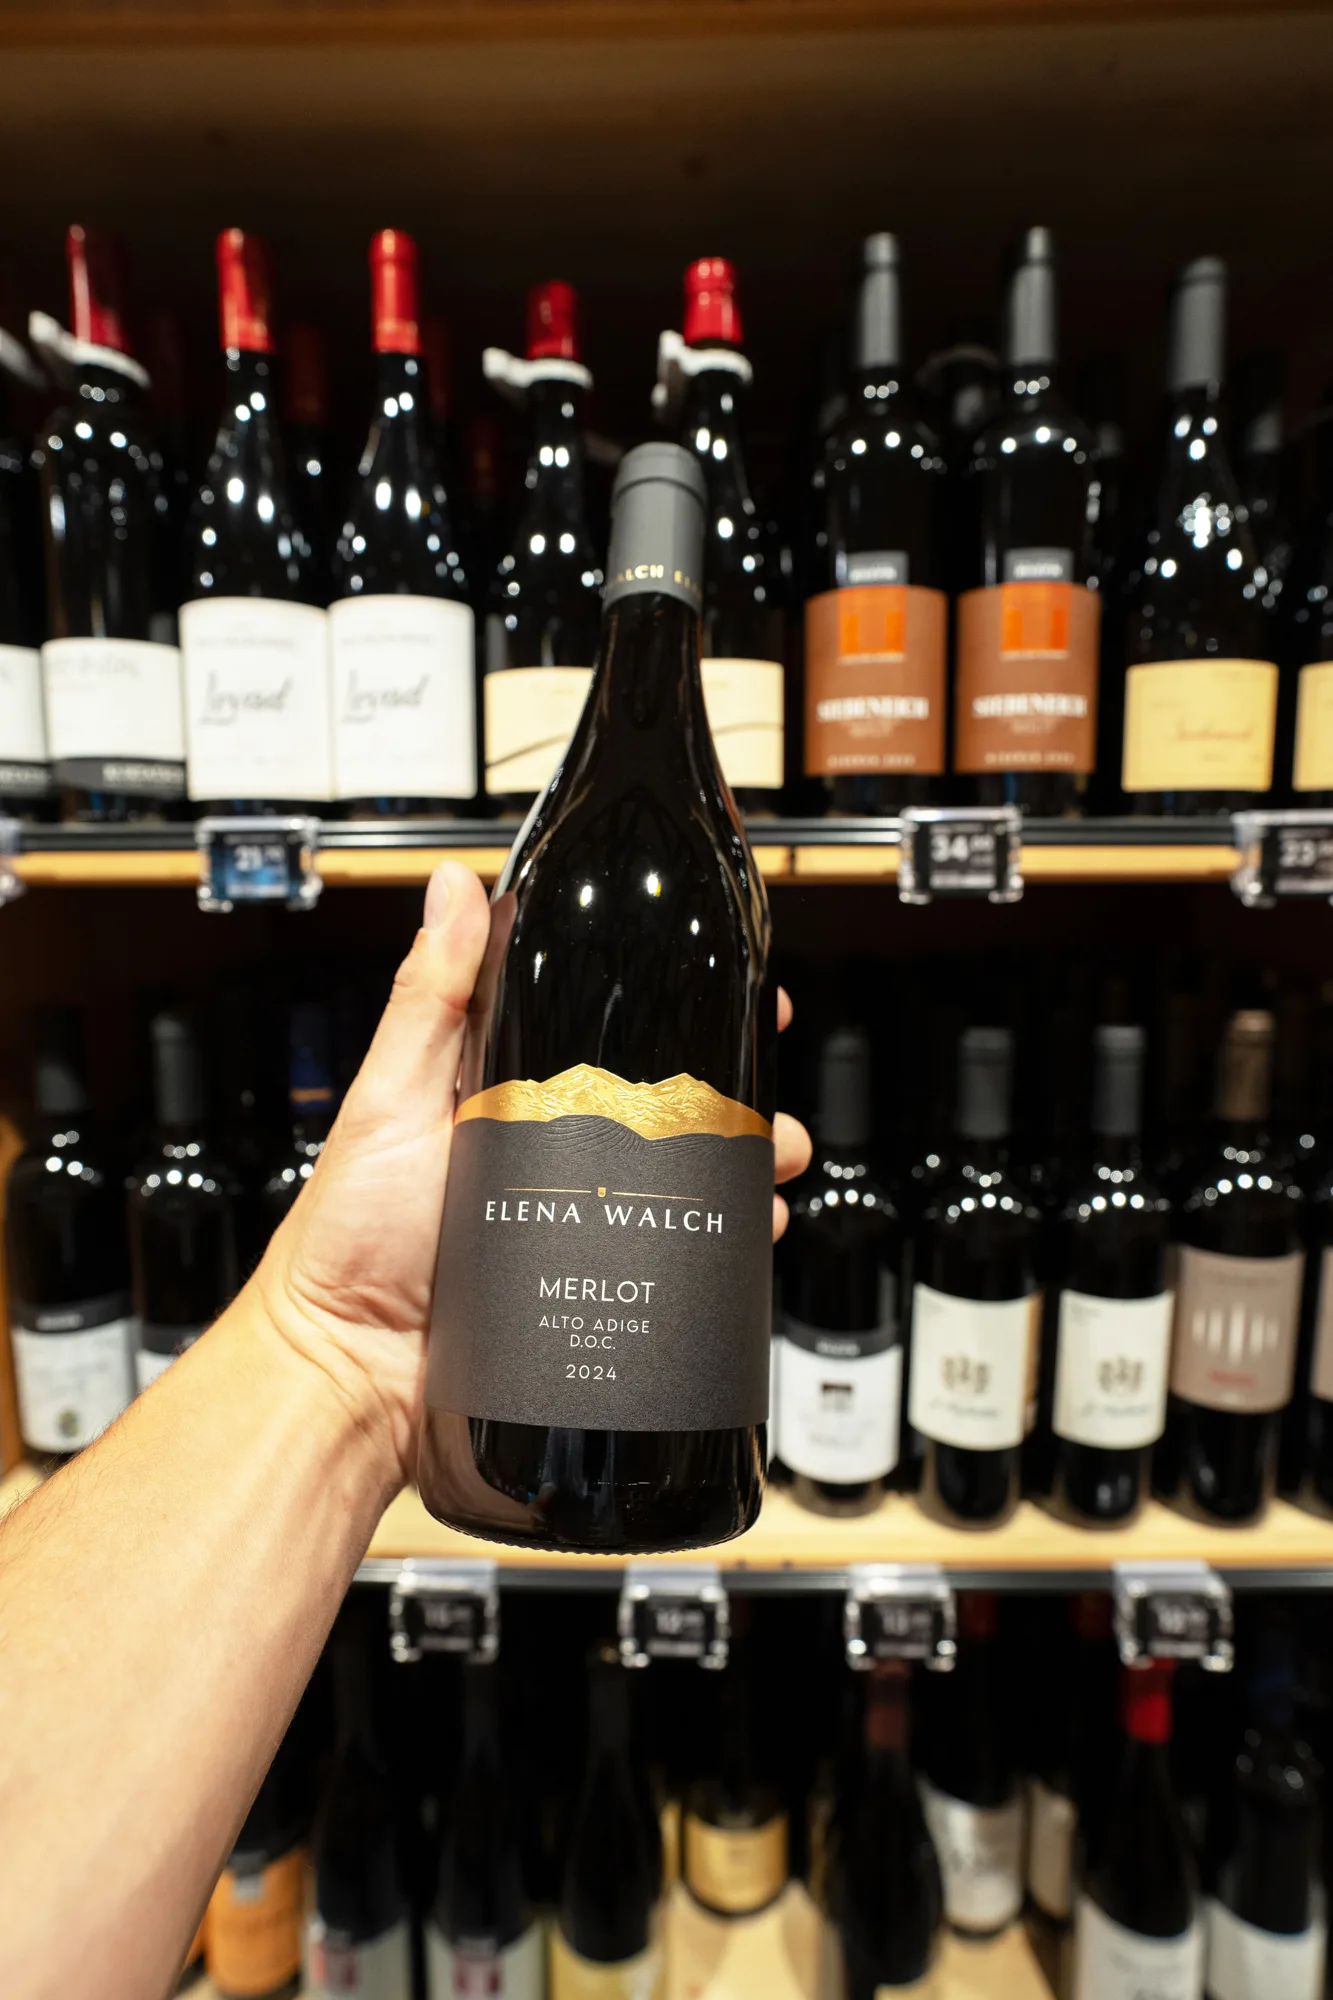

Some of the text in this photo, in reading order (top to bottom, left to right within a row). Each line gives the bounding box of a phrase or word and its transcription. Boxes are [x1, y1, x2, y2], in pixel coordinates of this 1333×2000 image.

[485, 1200, 724, 1234] ELENA WALCH
[538, 1276, 656, 1304] MERLOT
[538, 1314, 651, 1334] ALTO ADIGE
[569, 1333, 617, 1350] D.O.C.
[565, 1363, 617, 1381] 2024
